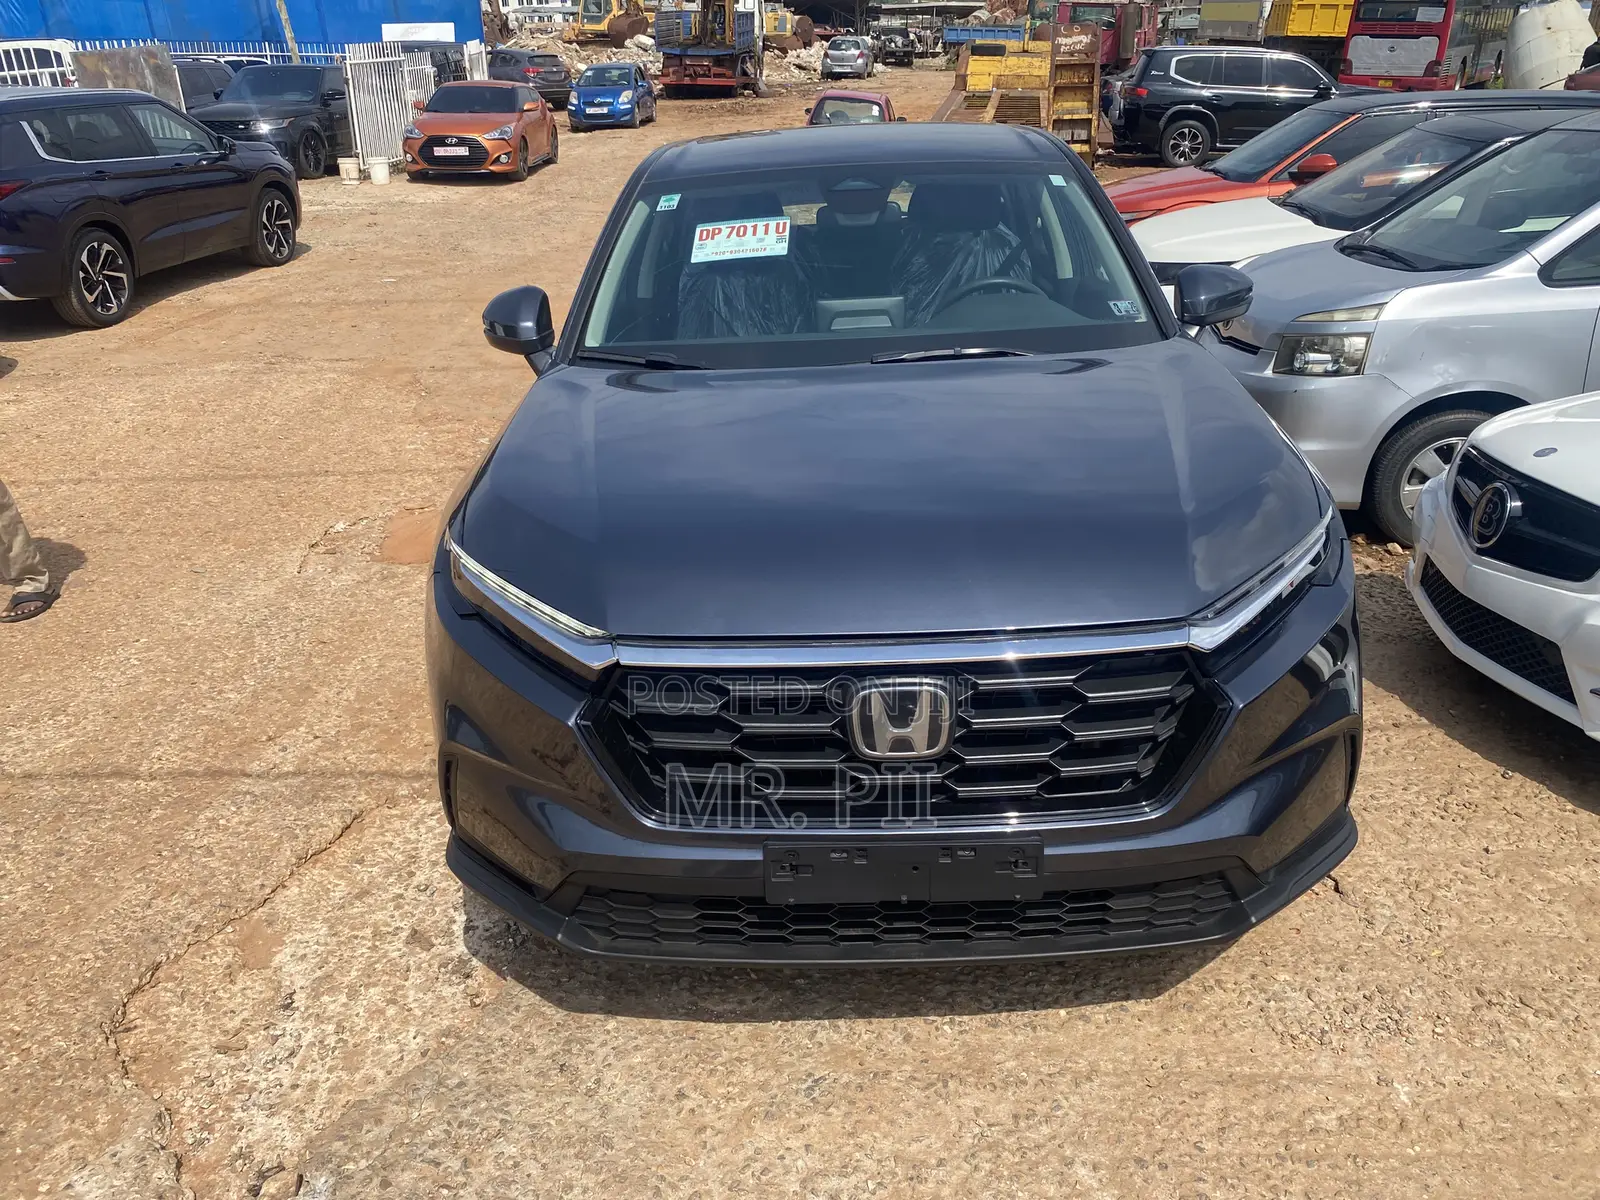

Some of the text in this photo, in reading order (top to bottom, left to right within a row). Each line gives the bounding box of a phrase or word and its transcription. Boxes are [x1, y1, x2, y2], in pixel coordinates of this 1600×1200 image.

[698, 221, 788, 242] DP 7011 U
